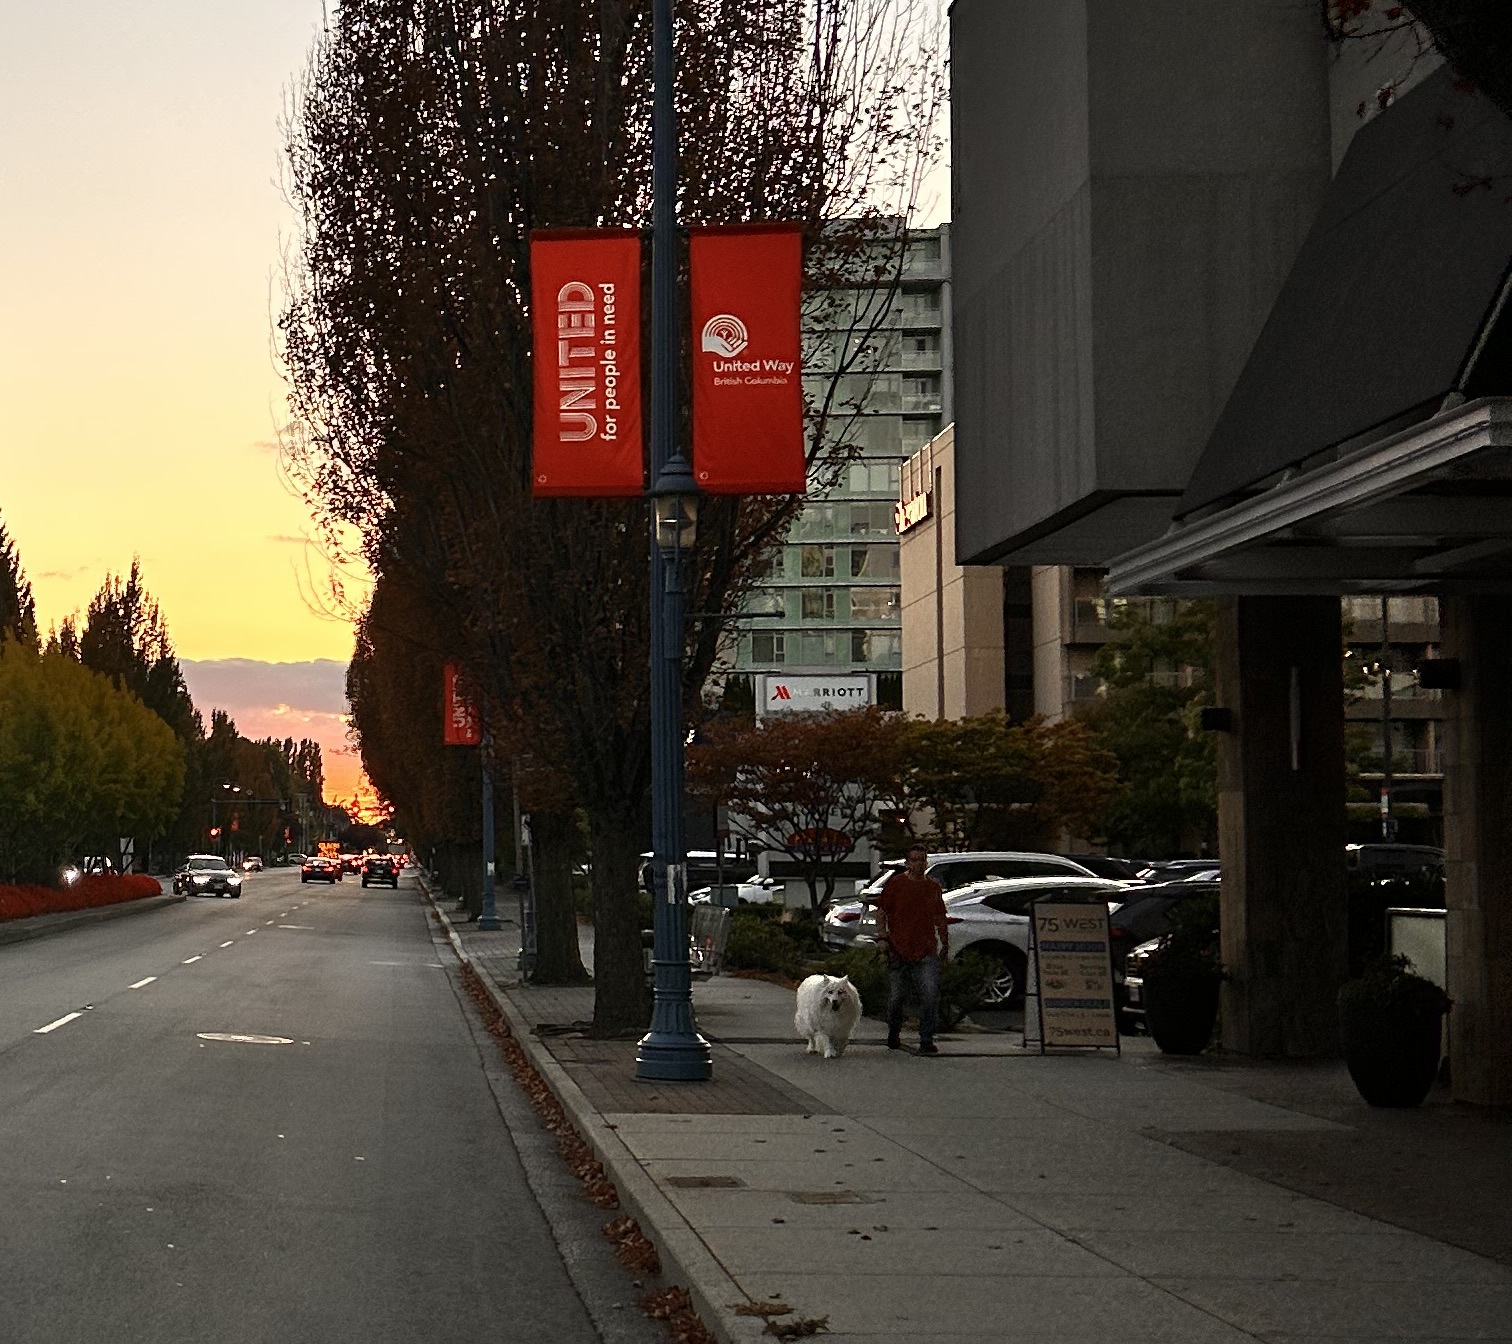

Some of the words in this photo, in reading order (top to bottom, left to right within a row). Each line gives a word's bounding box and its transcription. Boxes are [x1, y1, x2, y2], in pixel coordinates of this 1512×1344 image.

[598, 283, 615, 326] need
[600, 329, 616, 345] in
[557, 281, 597, 442] UNITED
[713, 359, 760, 373] United
[762, 359, 794, 375] Way
[600, 352, 620, 410] people
[713, 376, 743, 386] British
[744, 375, 788, 385] Columbia
[600, 415, 617, 441] for
[1037, 918, 1059, 932] 75
[1063, 918, 1105, 930] WEST
